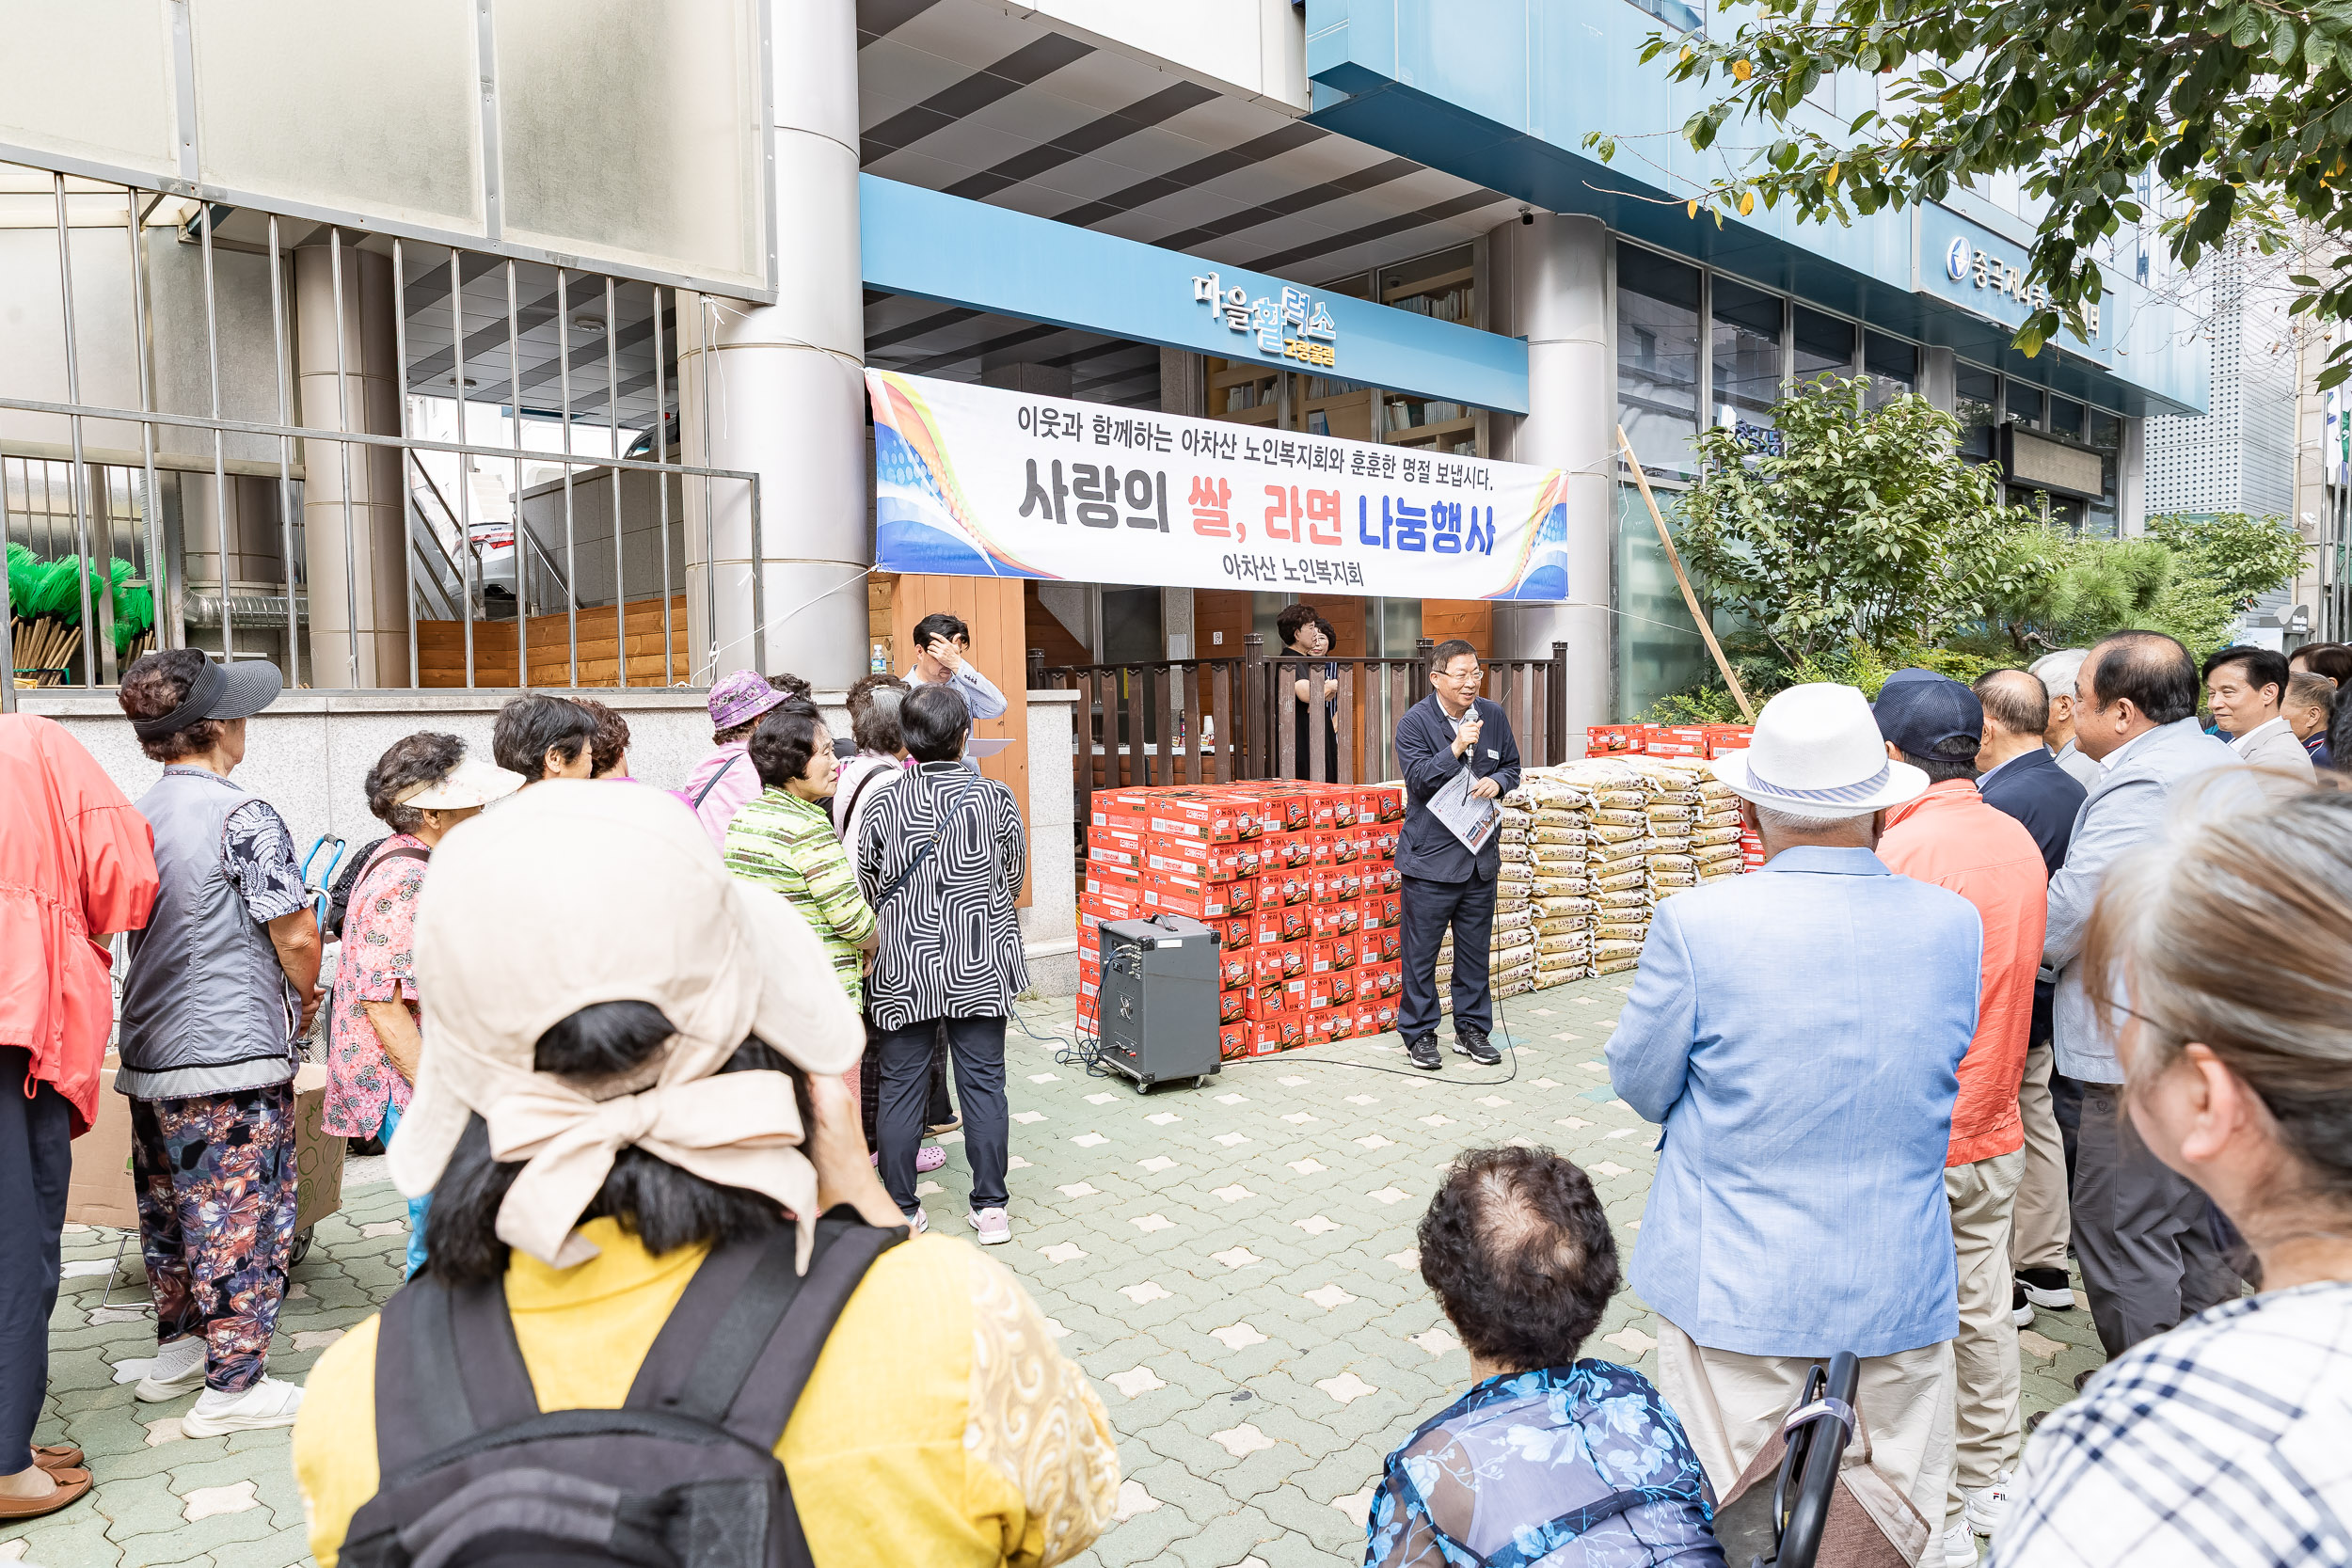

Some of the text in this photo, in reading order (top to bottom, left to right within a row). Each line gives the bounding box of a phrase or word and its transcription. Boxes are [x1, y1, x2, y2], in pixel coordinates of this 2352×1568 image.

[1018, 405, 1493, 491] 이웃과 함께하는 아차산 노인복지회와 훈훈한 명절 보냅시다.
[1019, 458, 1496, 556] 사랑의 쌀, 라면 나눔행사
[1223, 553, 1364, 587] 아차산 노인복지회
